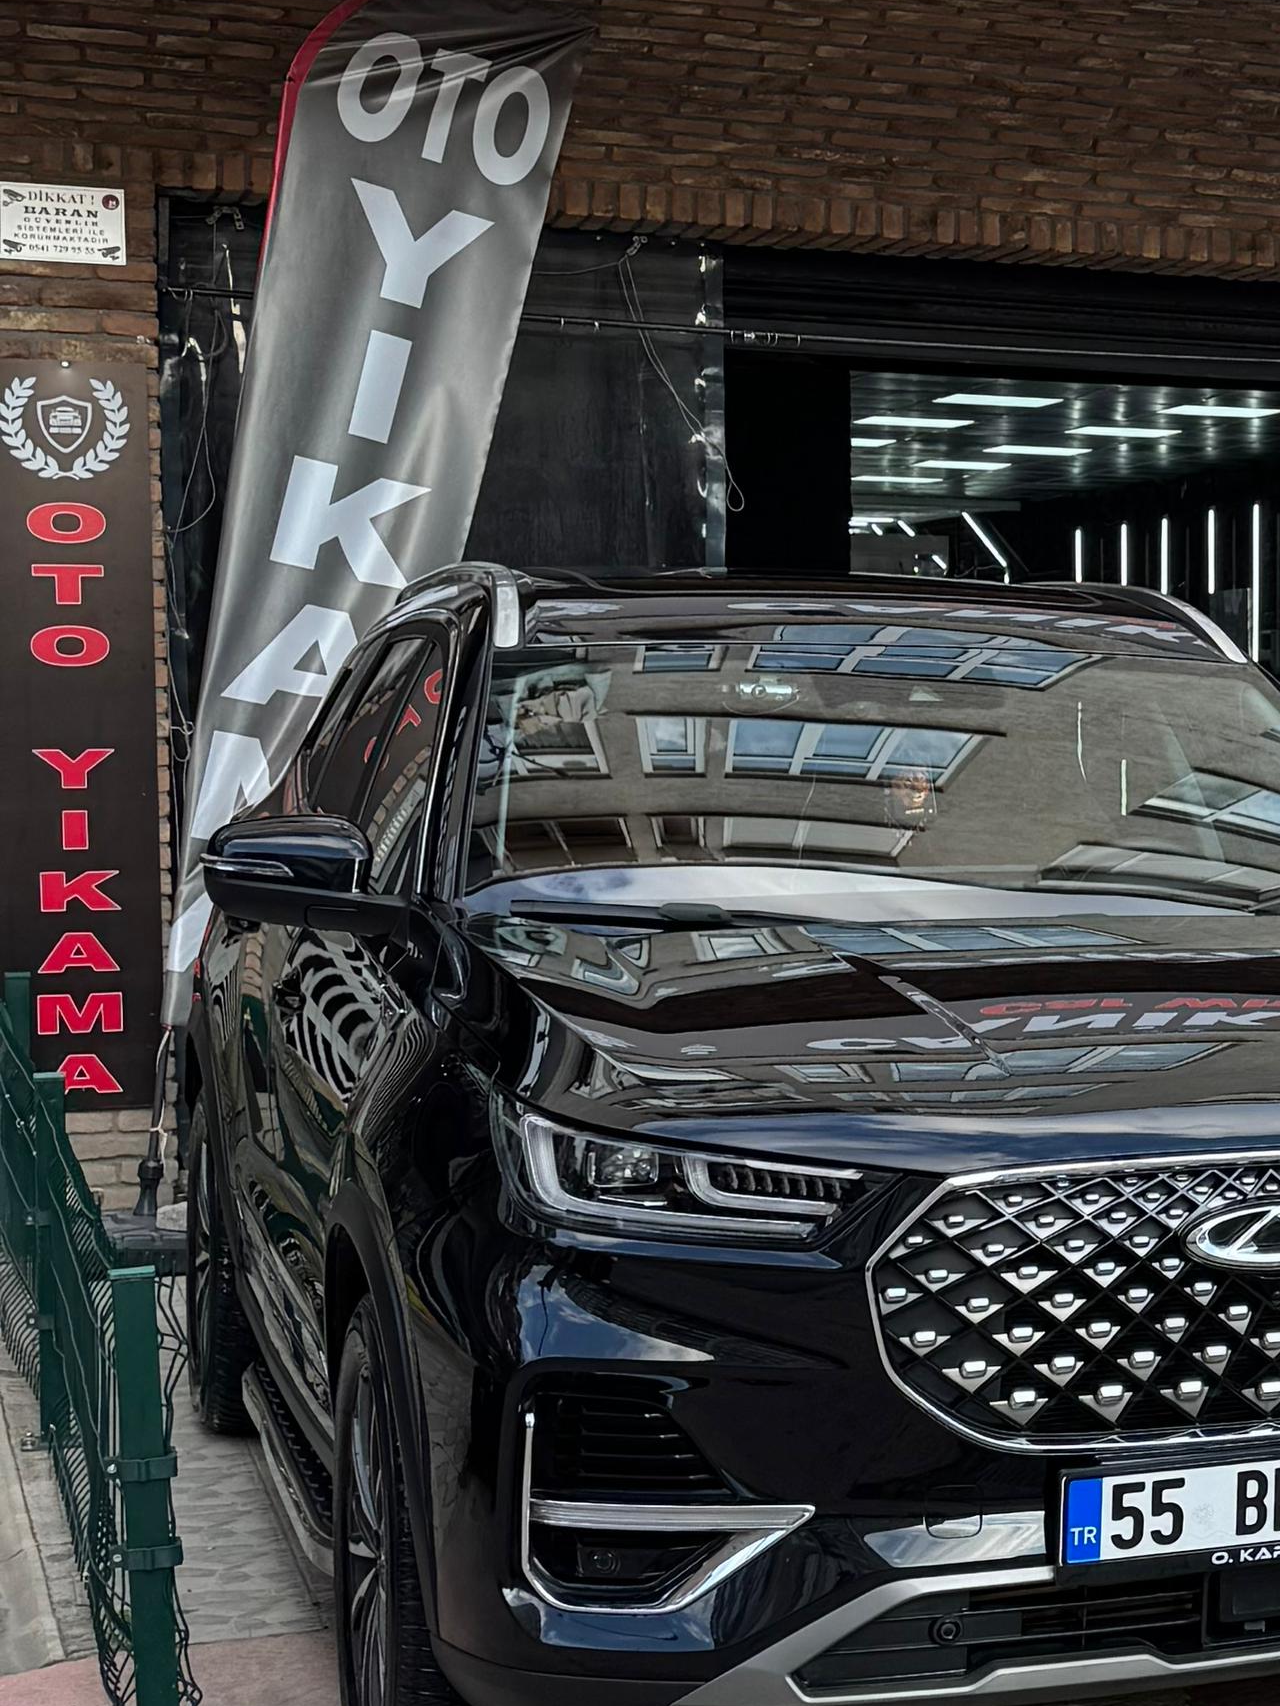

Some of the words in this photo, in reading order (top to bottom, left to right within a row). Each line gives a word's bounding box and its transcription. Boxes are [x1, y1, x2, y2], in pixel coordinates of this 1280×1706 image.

[336, 32, 551, 186] OTO
[27, 502, 110, 666] OTO
[32, 748, 123, 1094] YIKAMA
[1070, 1526, 1097, 1546] TR
[1110, 1477, 1186, 1550] 55
[1211, 1552, 1234, 1565] O.
